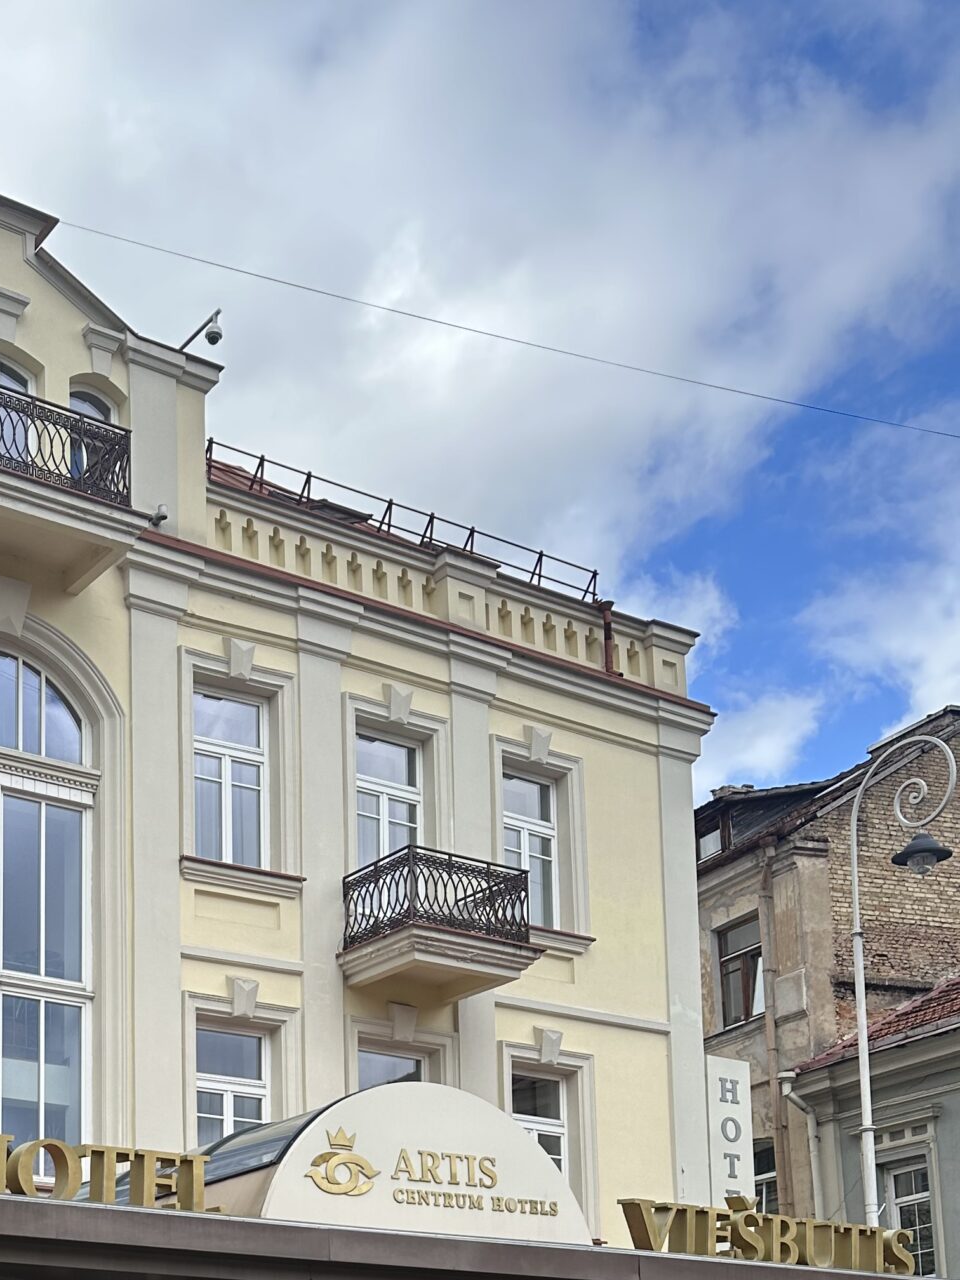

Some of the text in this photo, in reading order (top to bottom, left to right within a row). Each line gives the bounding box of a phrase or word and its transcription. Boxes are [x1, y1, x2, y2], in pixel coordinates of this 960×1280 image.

[391, 1148, 498, 1189] ARTIS
[392, 1187, 559, 1217] CENTRUM HOTELS
[617, 1195, 916, 1275] VIEŠBUTIS
